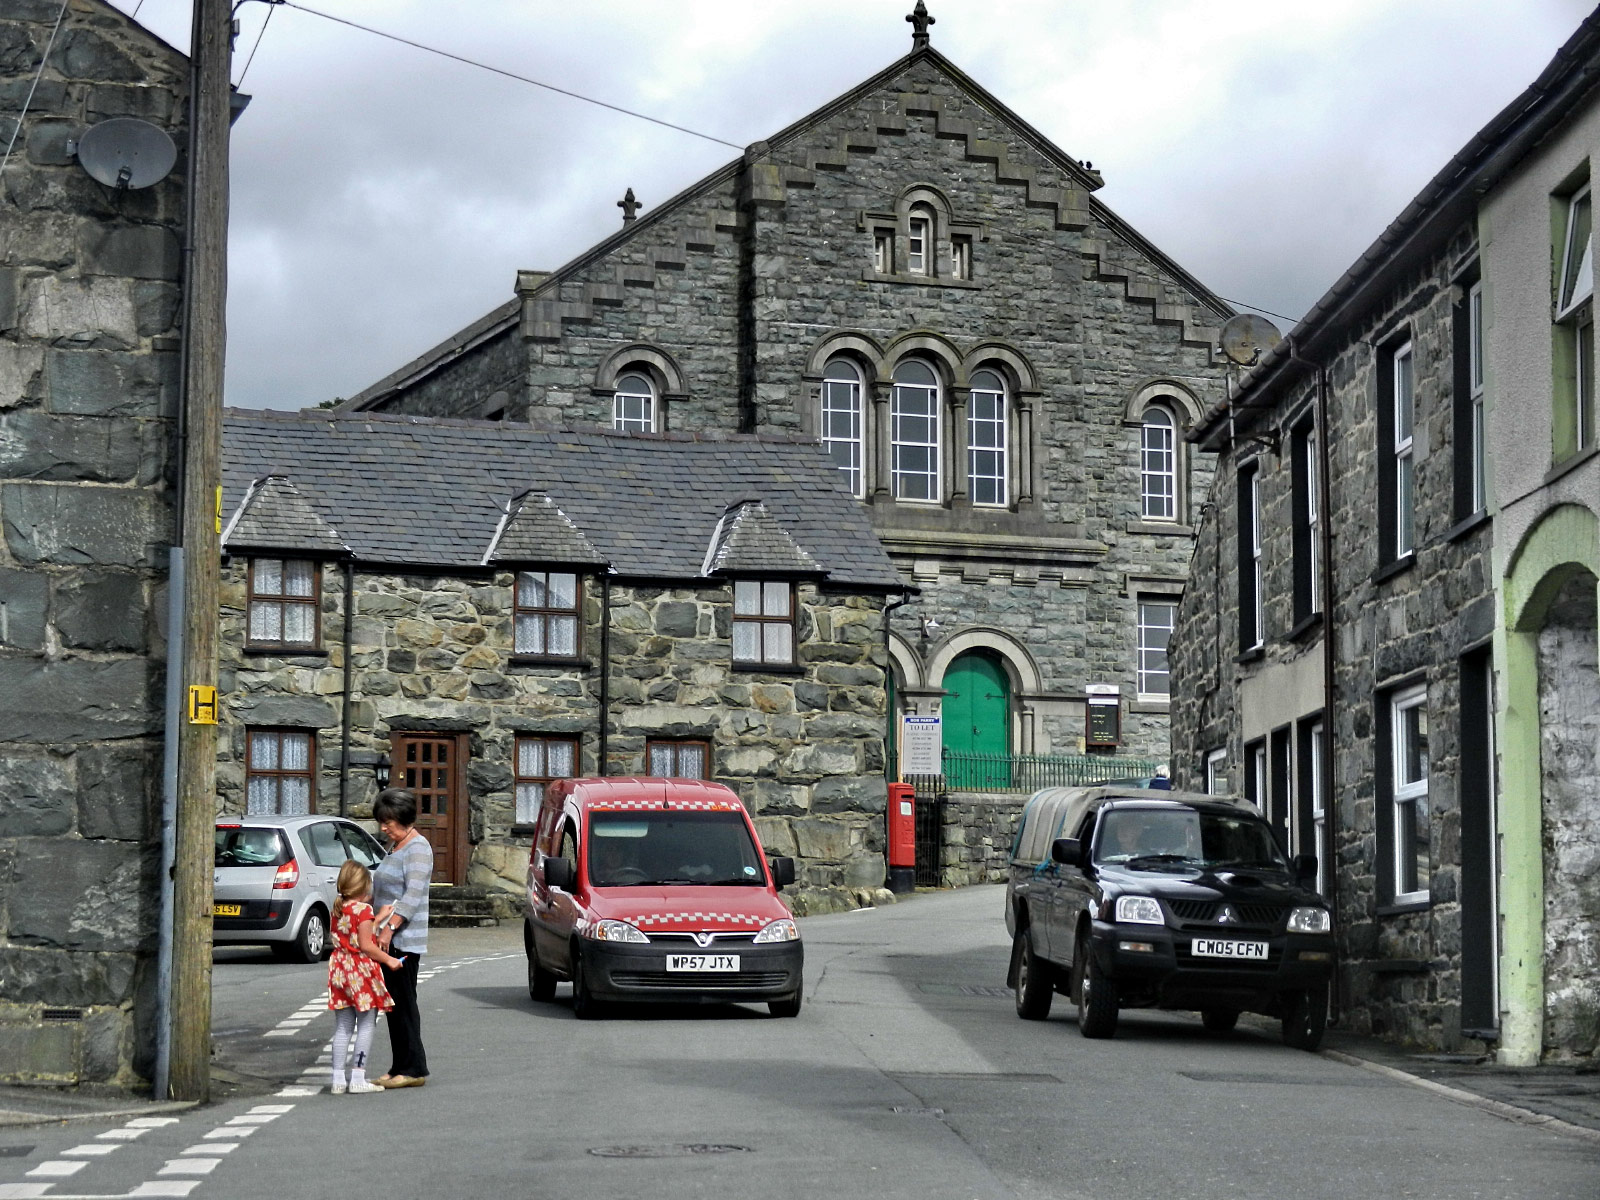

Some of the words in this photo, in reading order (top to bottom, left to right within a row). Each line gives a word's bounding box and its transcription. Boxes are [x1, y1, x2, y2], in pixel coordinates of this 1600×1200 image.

[194, 690, 215, 719] H
[222, 904, 239, 914] LSV
[1197, 940, 1233, 955] CW05
[1236, 943, 1264, 957] CFN
[672, 956, 706, 969] WP57
[709, 956, 734, 969] JTX
